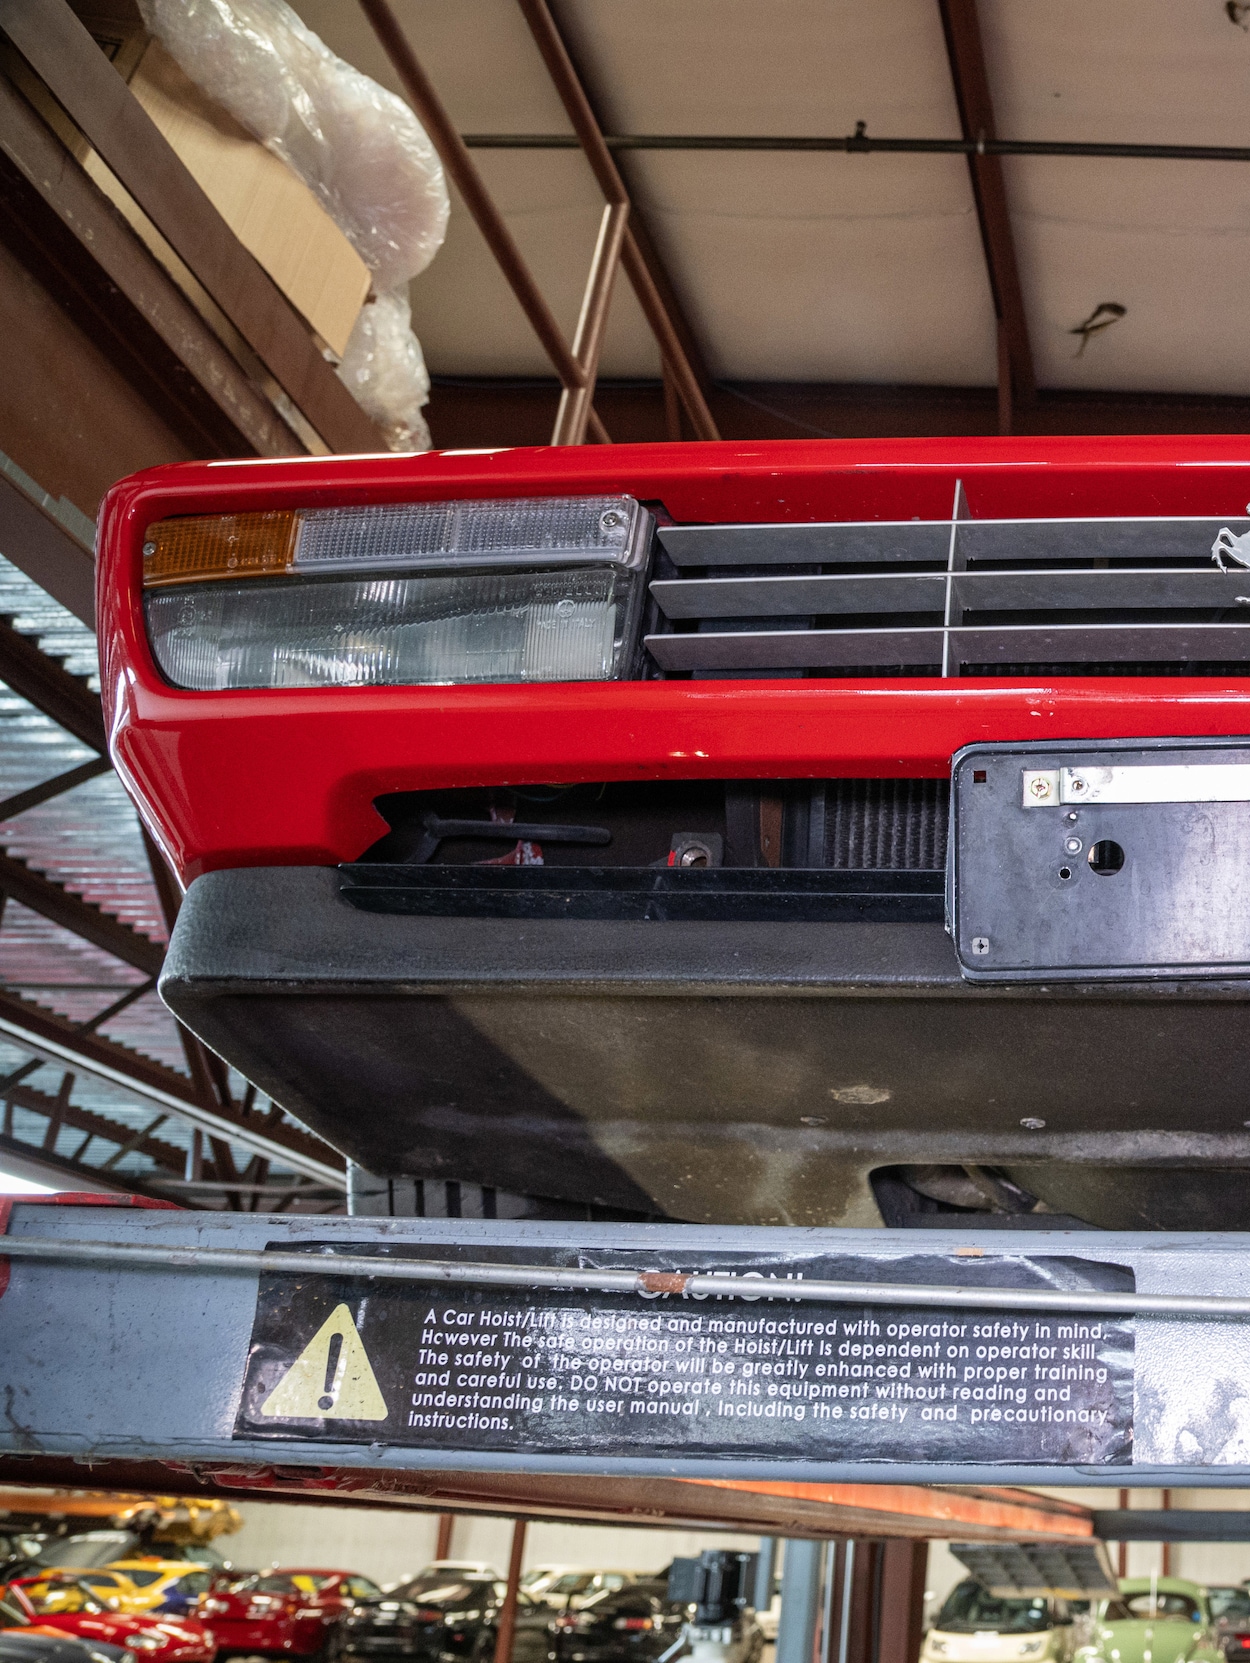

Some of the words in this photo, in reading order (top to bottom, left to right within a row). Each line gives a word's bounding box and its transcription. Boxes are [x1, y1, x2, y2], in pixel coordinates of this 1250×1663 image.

[424, 1308, 437, 1325] A
[443, 1309, 475, 1326] Car
[479, 1310, 556, 1329] Hoist/Lift
[580, 1313, 661, 1333] designed
[667, 1316, 702, 1332] and
[708, 1317, 837, 1335] manufactured
[843, 1320, 880, 1336] with
[887, 1321, 967, 1340] operator
[973, 1322, 1029, 1341] safety
[1035, 1322, 1050, 1338] in
[1057, 1323, 1107, 1340] mind,
[503, 1331, 532, 1347] The
[538, 1332, 575, 1349] safe
[582, 1335, 668, 1353] operation
[675, 1337, 693, 1352] of
[700, 1338, 728, 1353] the
[734, 1338, 814, 1356] Hoist/Lift
[838, 1340, 941, 1360] dependent
[947, 1345, 969, 1358] on
[976, 1342, 1057, 1361] operator
[418, 1349, 448, 1365] The
[454, 1351, 510, 1370] safety
[522, 1353, 541, 1369] of
[553, 1354, 581, 1370] the
[588, 1356, 669, 1374] operator
[675, 1358, 705, 1373] will
[712, 1358, 735, 1374] be
[742, 1359, 808, 1379] greatly
[815, 1361, 911, 1378] enhanced
[918, 1362, 957, 1378] with
[964, 1366, 1028, 1383] proper
[1034, 1364, 1108, 1383] training
[415, 1370, 450, 1386] and
[457, 1372, 521, 1388] careful
[527, 1375, 563, 1391] use.
[570, 1375, 598, 1391] DO
[605, 1376, 643, 1392] NOT
[648, 1378, 722, 1396] operate
[729, 1379, 761, 1396] this
[767, 1381, 869, 1400] equipment
[875, 1383, 947, 1400] without
[953, 1384, 1027, 1404] reading
[1034, 1385, 1071, 1401] and
[408, 1411, 514, 1431] instructions.
[412, 1391, 543, 1413] understanding
[550, 1395, 579, 1412] the
[586, 1399, 624, 1413] user
[812, 1402, 843, 1419] the
[850, 1402, 908, 1423] safety
[921, 1405, 957, 1421] and
[971, 1406, 1108, 1426] precautionary
